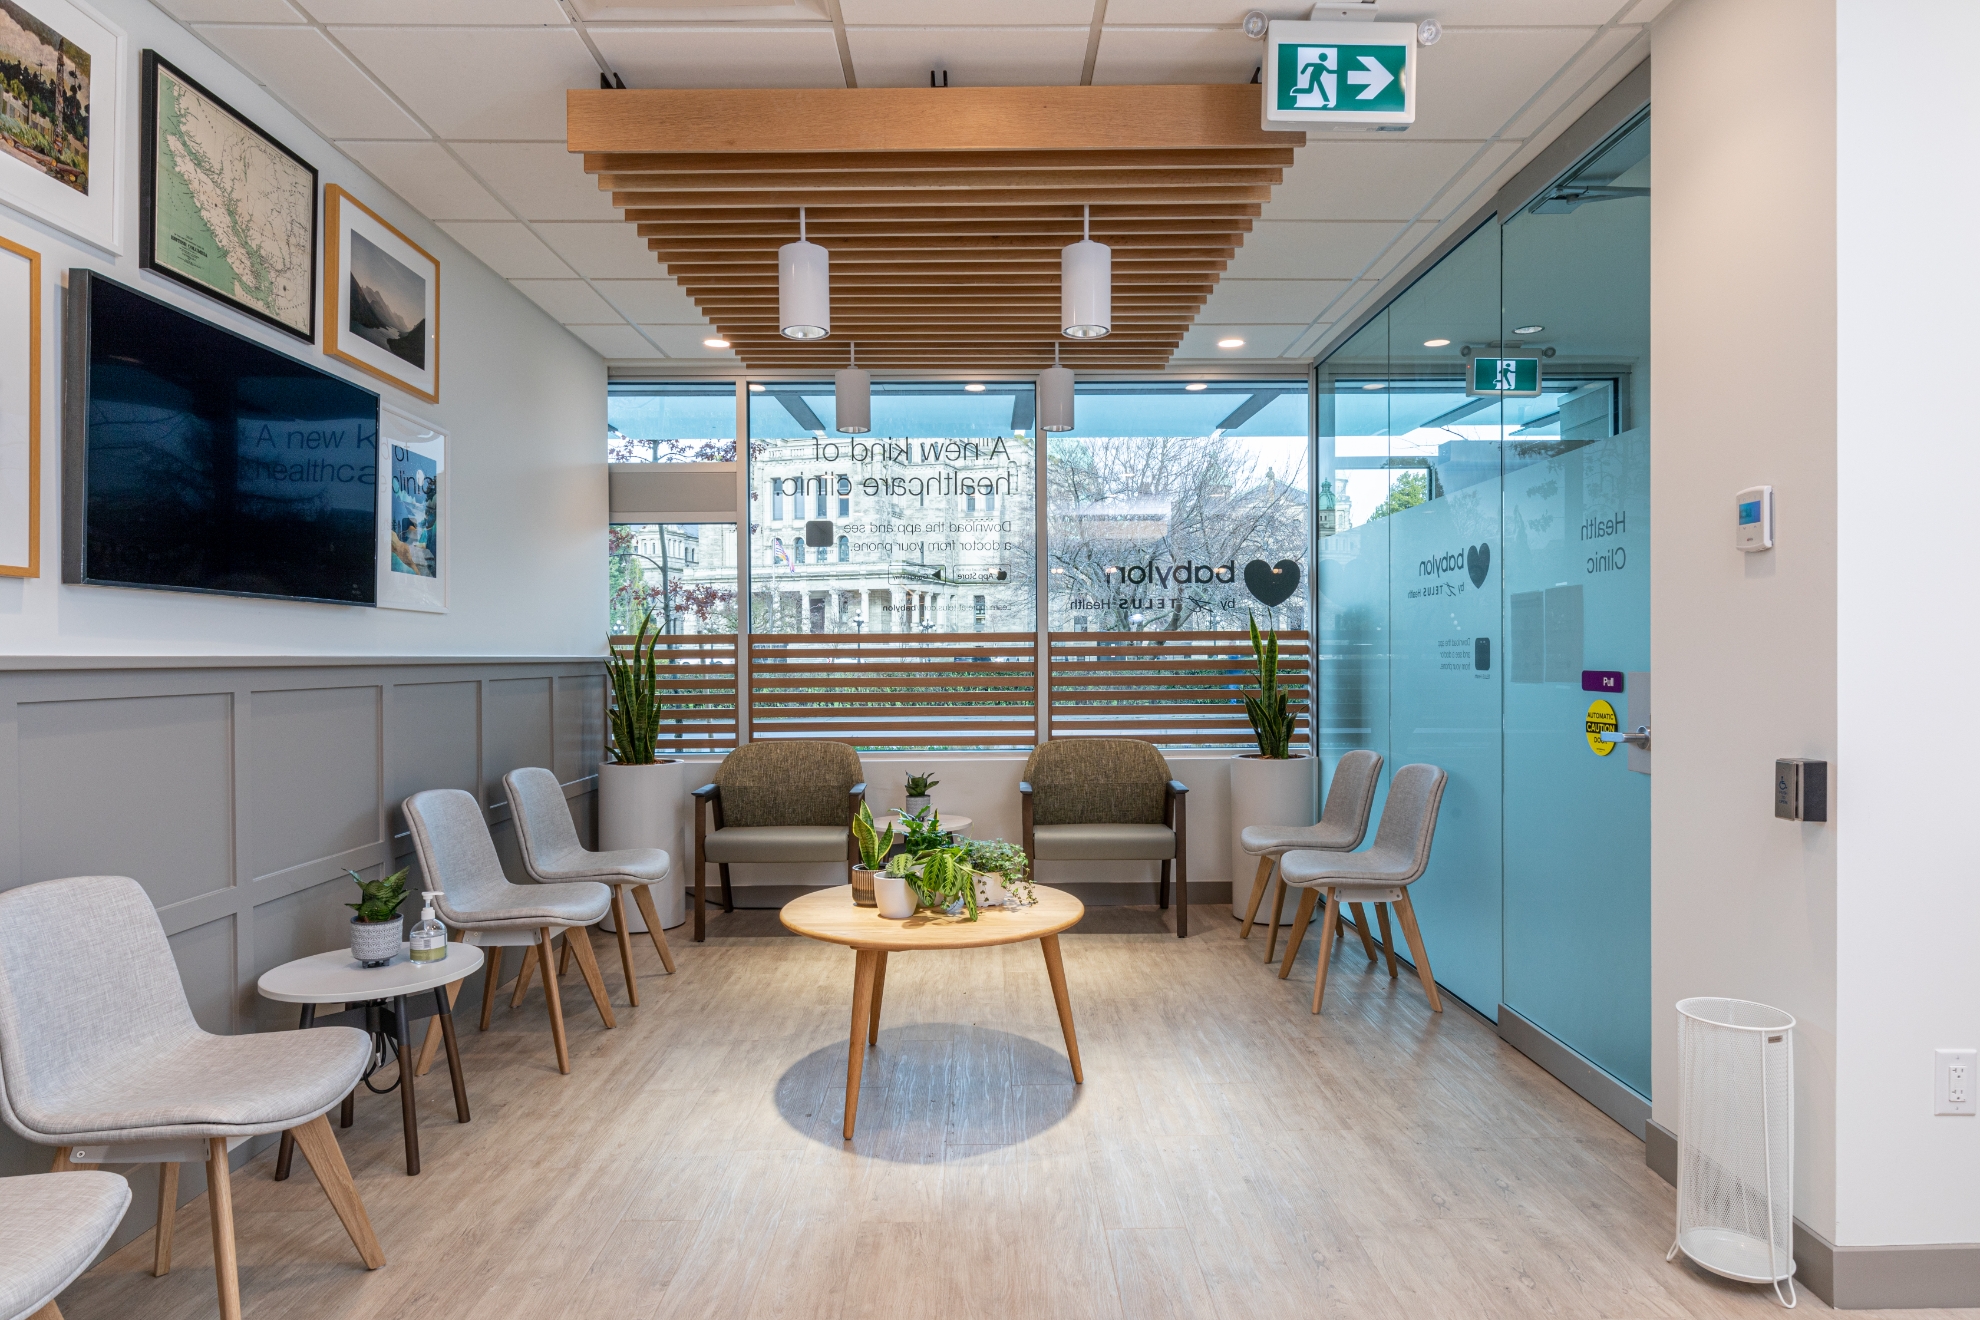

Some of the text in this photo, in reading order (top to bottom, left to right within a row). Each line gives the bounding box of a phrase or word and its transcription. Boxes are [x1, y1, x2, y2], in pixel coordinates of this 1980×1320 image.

[256, 424, 276, 448] A
[287, 430, 345, 450] new
[1603, 677, 1614, 686] Pull
[1587, 712, 1614, 720] AUTOMATIC
[1586, 723, 1615, 732] CAUTION
